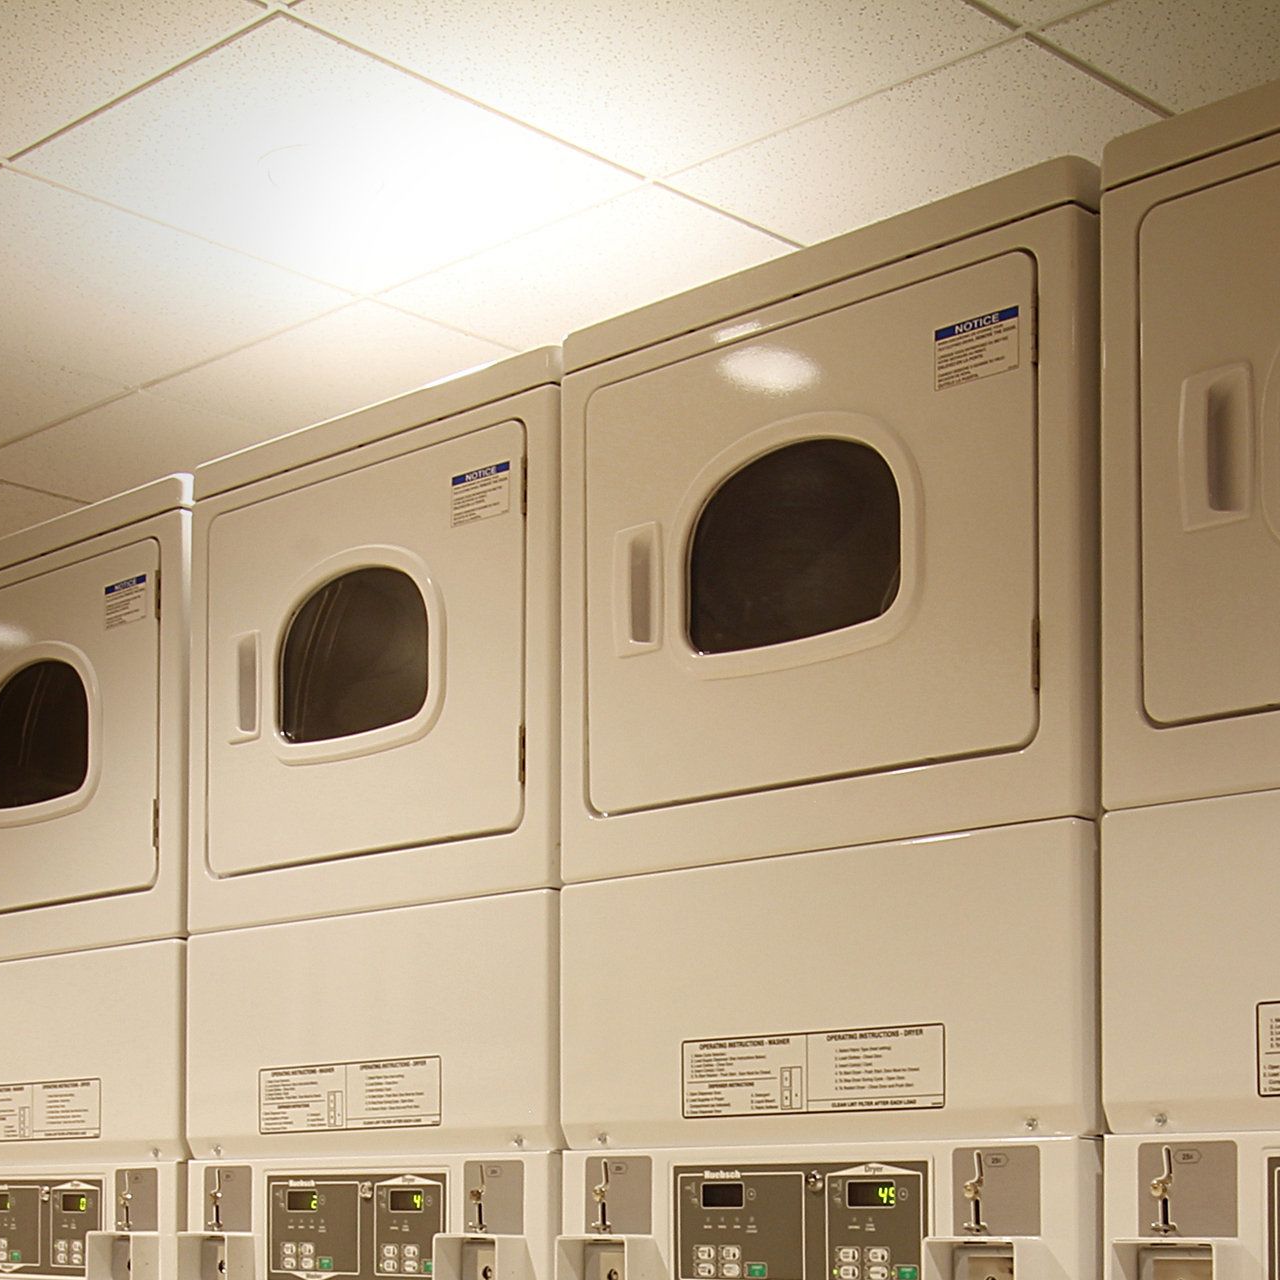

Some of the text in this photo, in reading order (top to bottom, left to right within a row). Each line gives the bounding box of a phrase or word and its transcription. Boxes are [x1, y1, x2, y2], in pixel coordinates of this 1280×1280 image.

[955, 313, 999, 334] NOTICE
[465, 466, 497, 481] NOTICE
[859, 1031, 899, 1039] INSTRUCTIONS
[728, 1040, 764, 1048] INSTRUCTIONS
